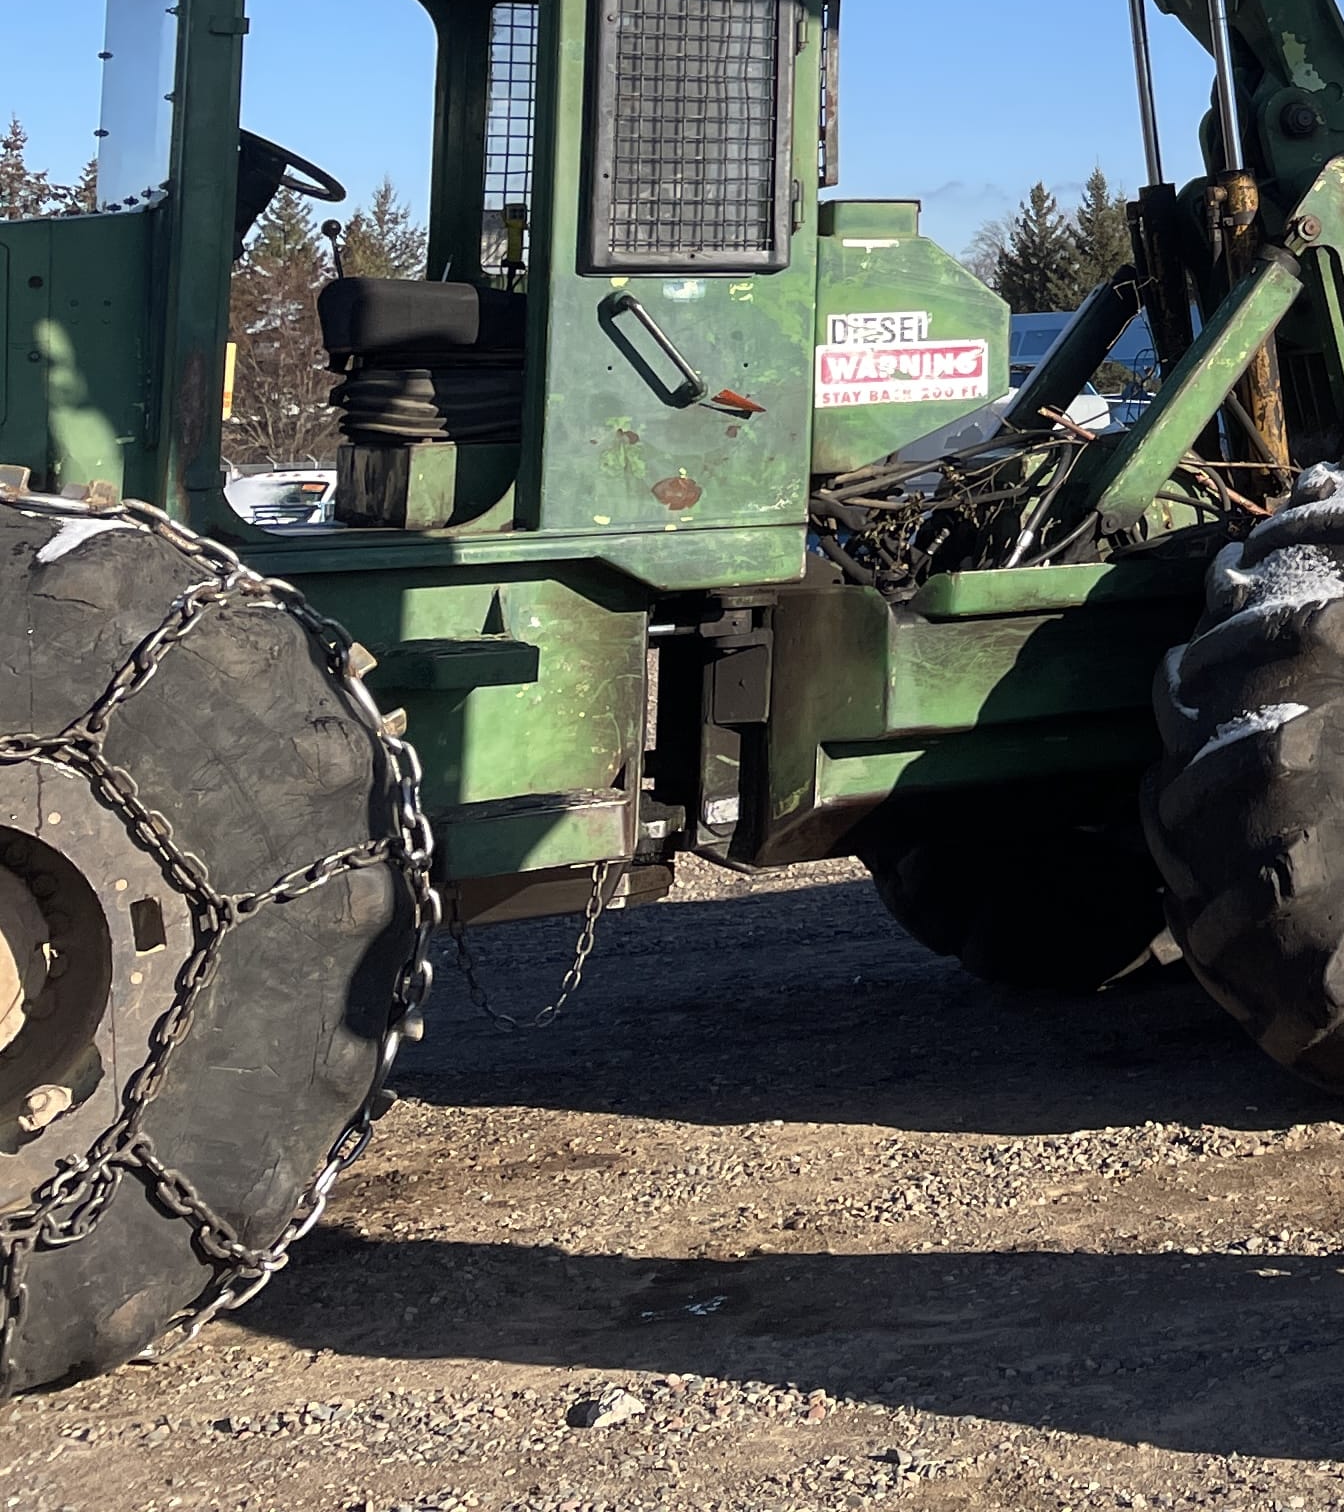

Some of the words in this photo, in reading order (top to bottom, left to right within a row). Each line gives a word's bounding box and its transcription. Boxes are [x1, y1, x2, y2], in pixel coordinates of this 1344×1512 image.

[831, 316, 929, 345] DIESEL
[826, 349, 980, 380] WARNING
[822, 390, 861, 405] STAY
[921, 387, 955, 400] 200
